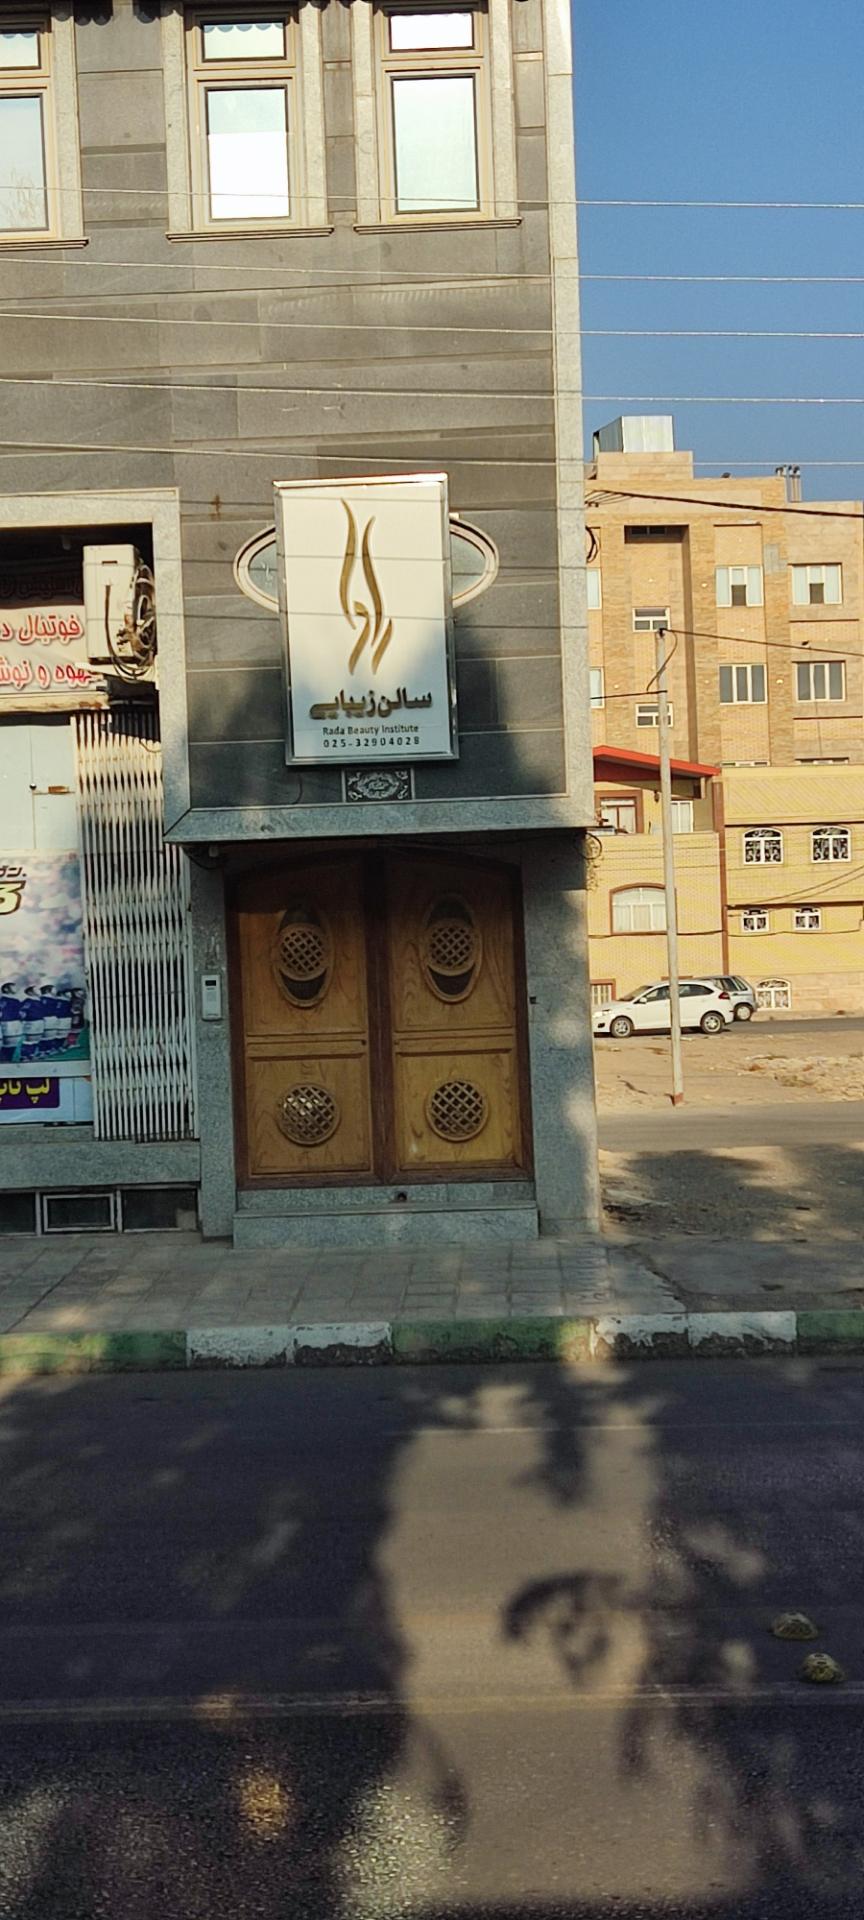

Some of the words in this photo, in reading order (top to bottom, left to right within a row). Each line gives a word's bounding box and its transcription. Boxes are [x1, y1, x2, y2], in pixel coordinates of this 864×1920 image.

[18, 613, 82, 644] فوتبال
[377, 686, 432, 718] سالن
[322, 726, 345, 736] Rada
[347, 725, 379, 736] Beauty
[381, 724, 419, 735] Institute
[323, 736, 420, 748] 025-32904028
